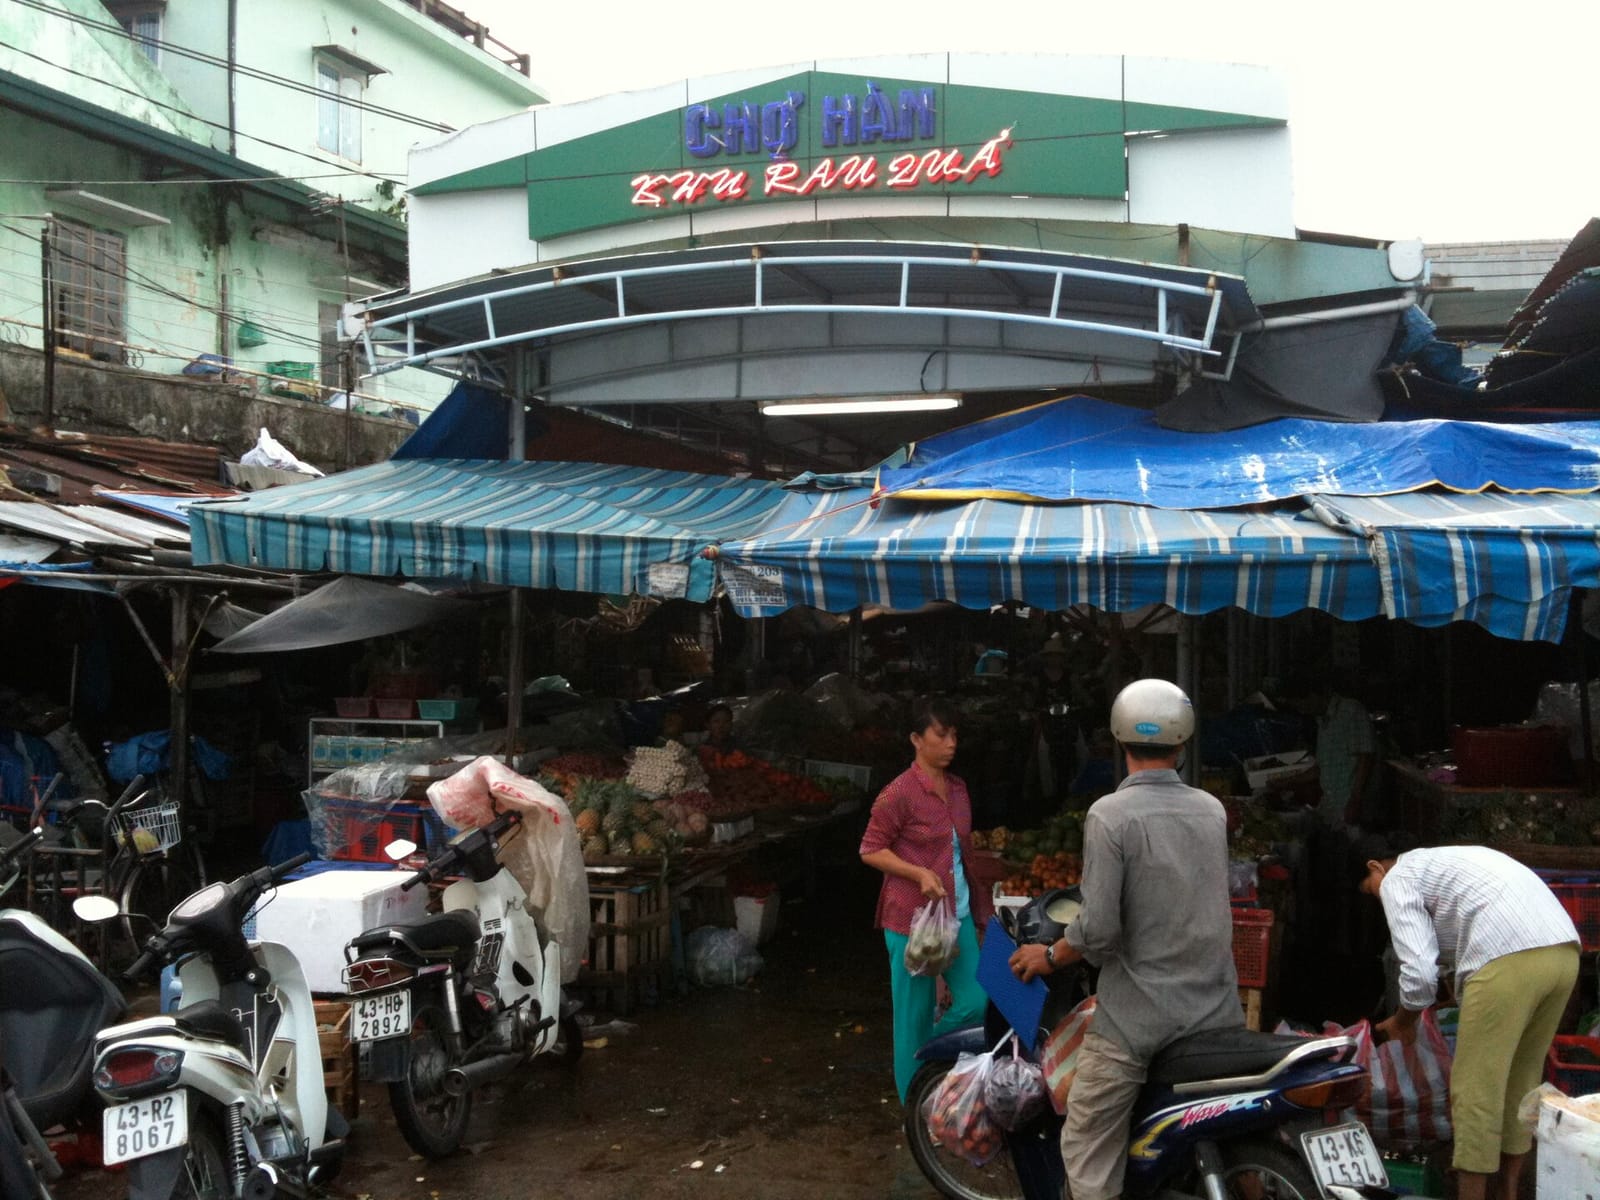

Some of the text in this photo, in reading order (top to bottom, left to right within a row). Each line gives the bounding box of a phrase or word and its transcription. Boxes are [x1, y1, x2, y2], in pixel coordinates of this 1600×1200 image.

[686, 80, 935, 159] CHỢ HÀN
[631, 168, 749, 207] KHU
[764, 155, 877, 194] RAU
[361, 1014, 401, 1038] 2892
[117, 1097, 174, 1130] 43-R2
[117, 1121, 175, 1156] 8067
